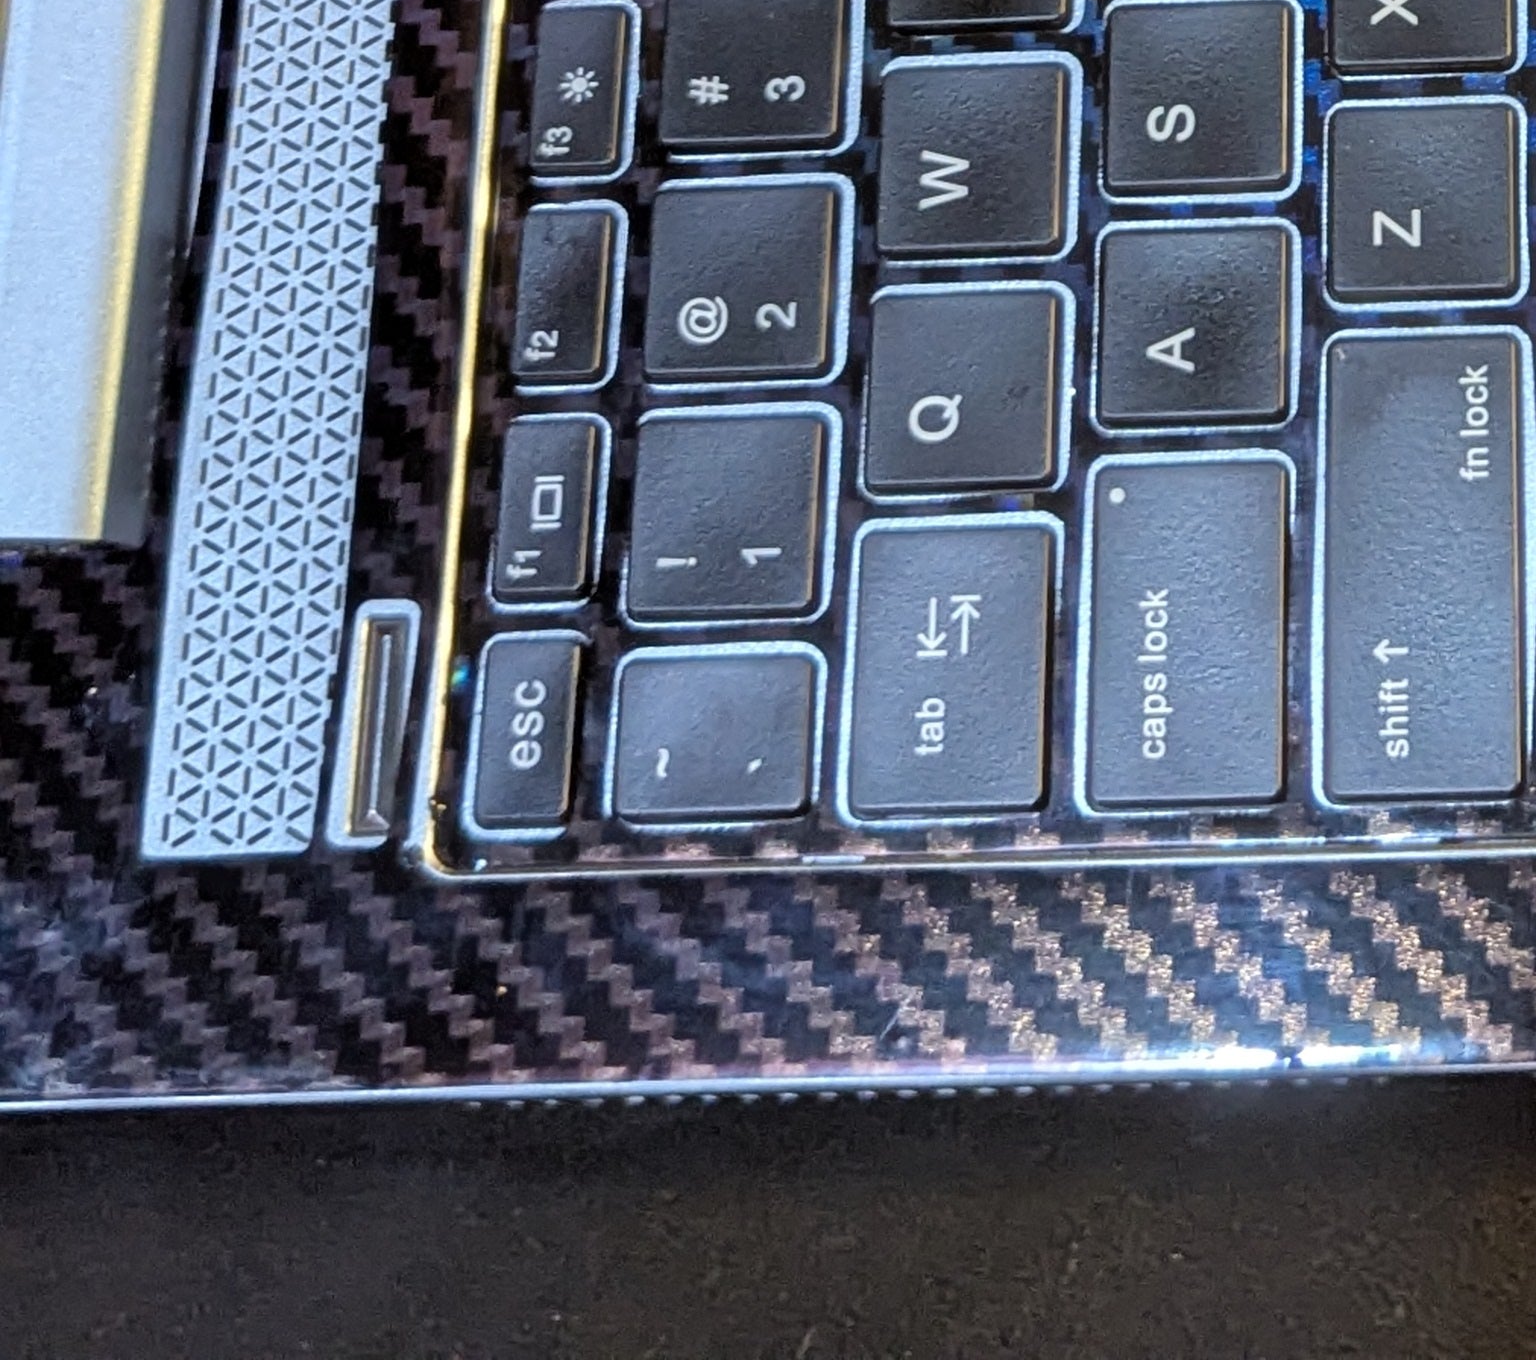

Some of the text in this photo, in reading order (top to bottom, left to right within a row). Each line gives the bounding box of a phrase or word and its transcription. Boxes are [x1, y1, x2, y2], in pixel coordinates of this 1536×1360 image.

[687, 75, 730, 105] #
[764, 75, 806, 102] 3
[536, 125, 573, 157] f3
[1145, 103, 1196, 143] S
[918, 149, 970, 211] W
[1372, 208, 1422, 248] Z
[676, 295, 729, 345] @
[755, 301, 798, 330] 2
[522, 329, 559, 362] f2
[1145, 327, 1196, 373] A
[908, 394, 963, 443] Q
[1458, 364, 1490, 482] fn lock
[505, 550, 542, 580] f1
[740, 547, 782, 567] 1
[1136, 588, 1174, 760] caps lock
[509, 679, 546, 769] esc
[913, 697, 946, 756] tab
[1378, 677, 1409, 759] shift
